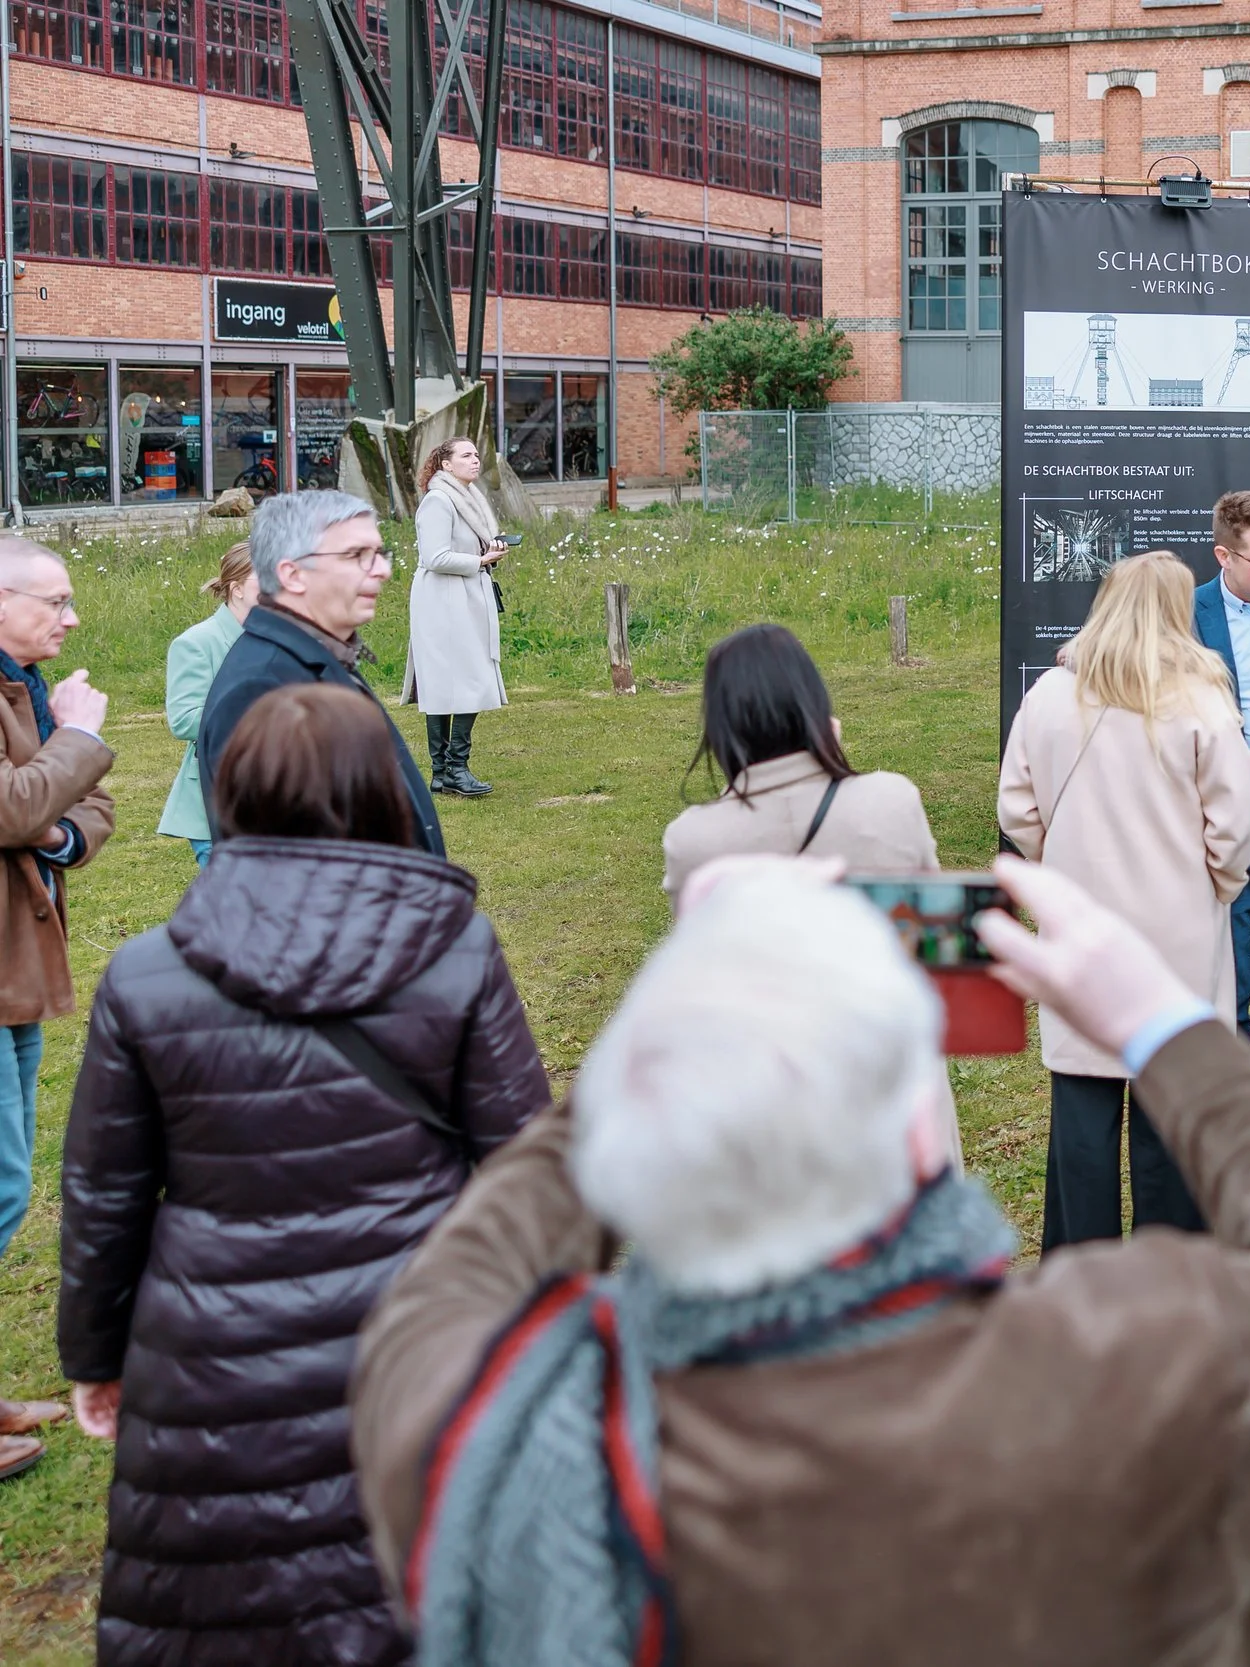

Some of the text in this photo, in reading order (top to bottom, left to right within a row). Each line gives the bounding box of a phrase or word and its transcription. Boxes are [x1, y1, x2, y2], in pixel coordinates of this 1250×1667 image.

[1142, 280, 1214, 295] WERKING
[226, 298, 286, 327] ingang
[1024, 465, 1195, 476] DE SCHACHTBOK BESTAAT UIT:
[1089, 489, 1164, 500] LIFTSCHACHT
